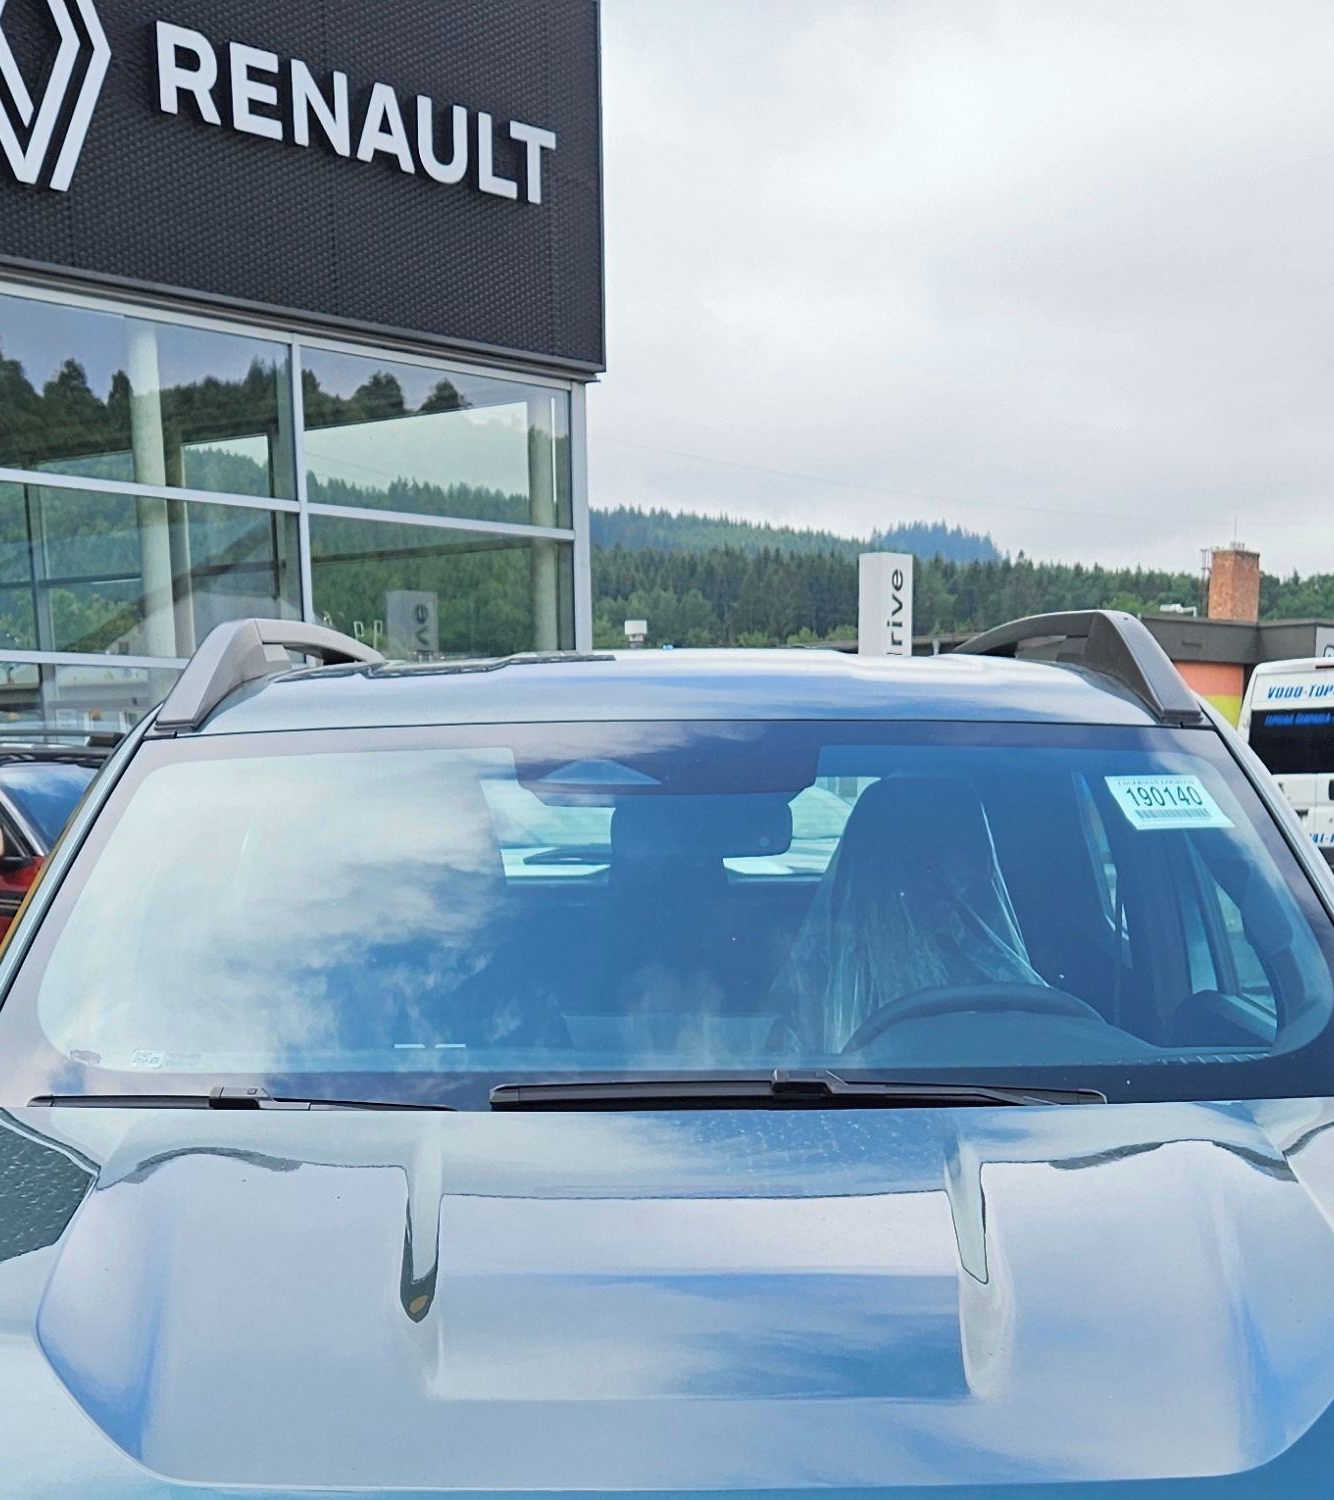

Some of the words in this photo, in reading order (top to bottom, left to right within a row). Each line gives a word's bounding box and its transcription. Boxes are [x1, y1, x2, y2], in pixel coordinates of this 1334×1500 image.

[156, 20, 556, 204] RENAULT
[887, 568, 905, 657] rive
[1126, 786, 1204, 807] 190140
